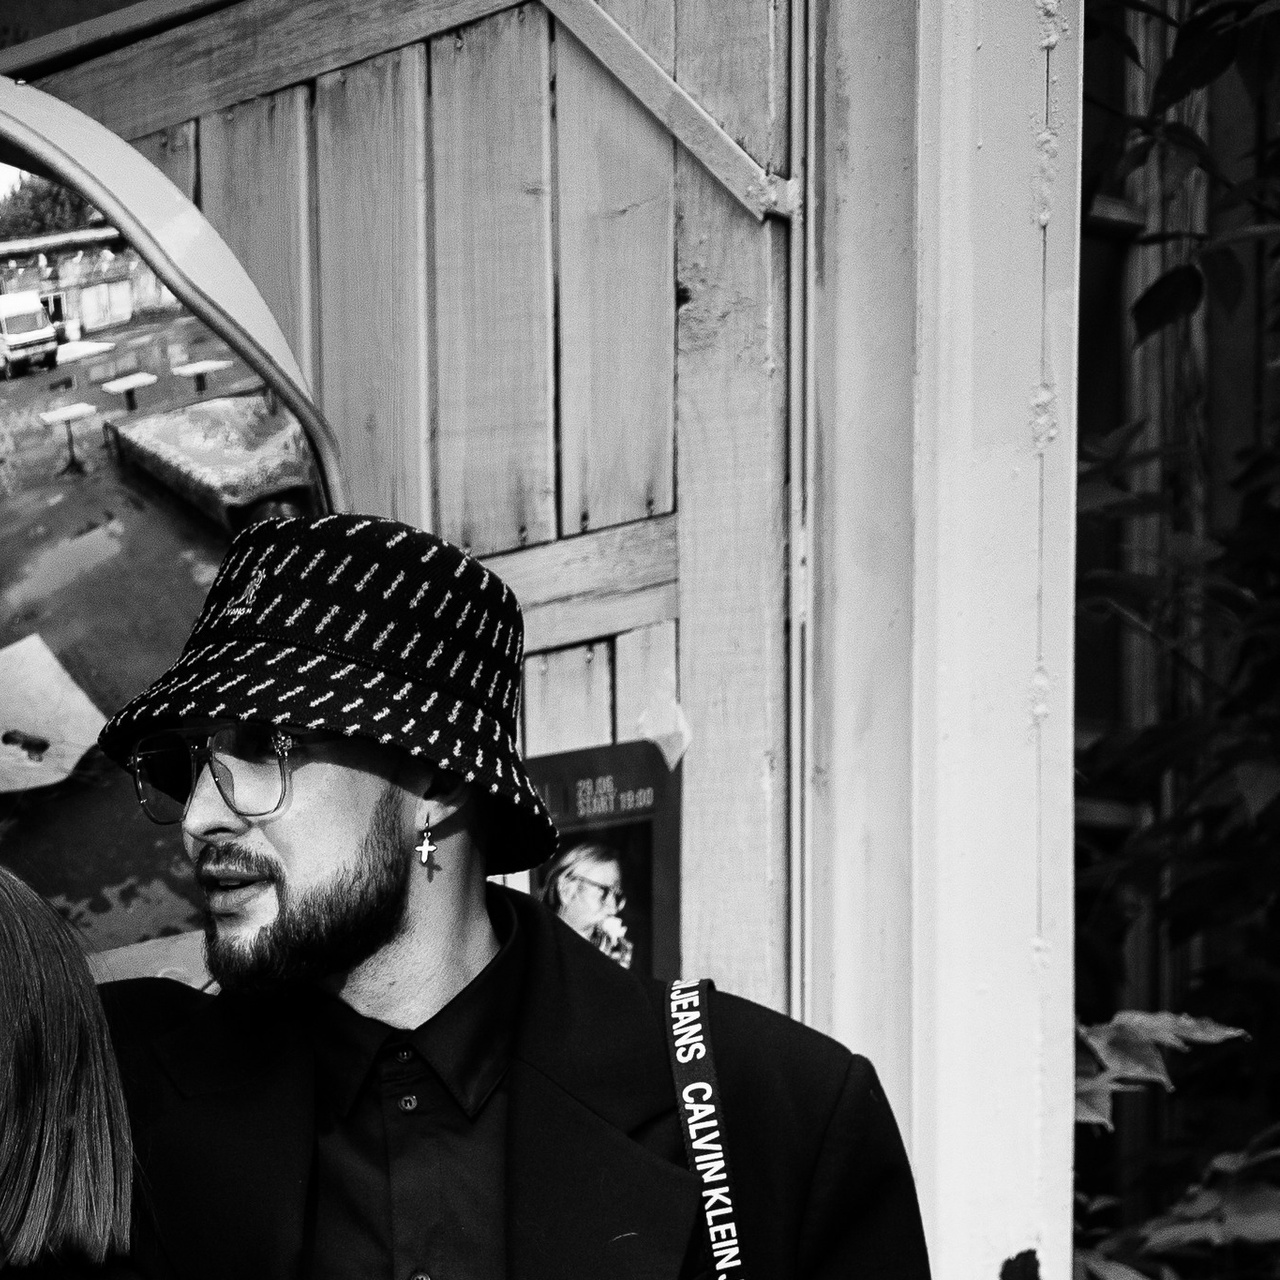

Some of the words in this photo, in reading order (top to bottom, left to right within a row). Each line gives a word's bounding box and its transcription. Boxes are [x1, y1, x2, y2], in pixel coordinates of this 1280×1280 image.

[670, 989, 707, 1064] JEANS
[682, 1082, 727, 1183] CALVIN
[701, 1186, 742, 1271] KLEIN
